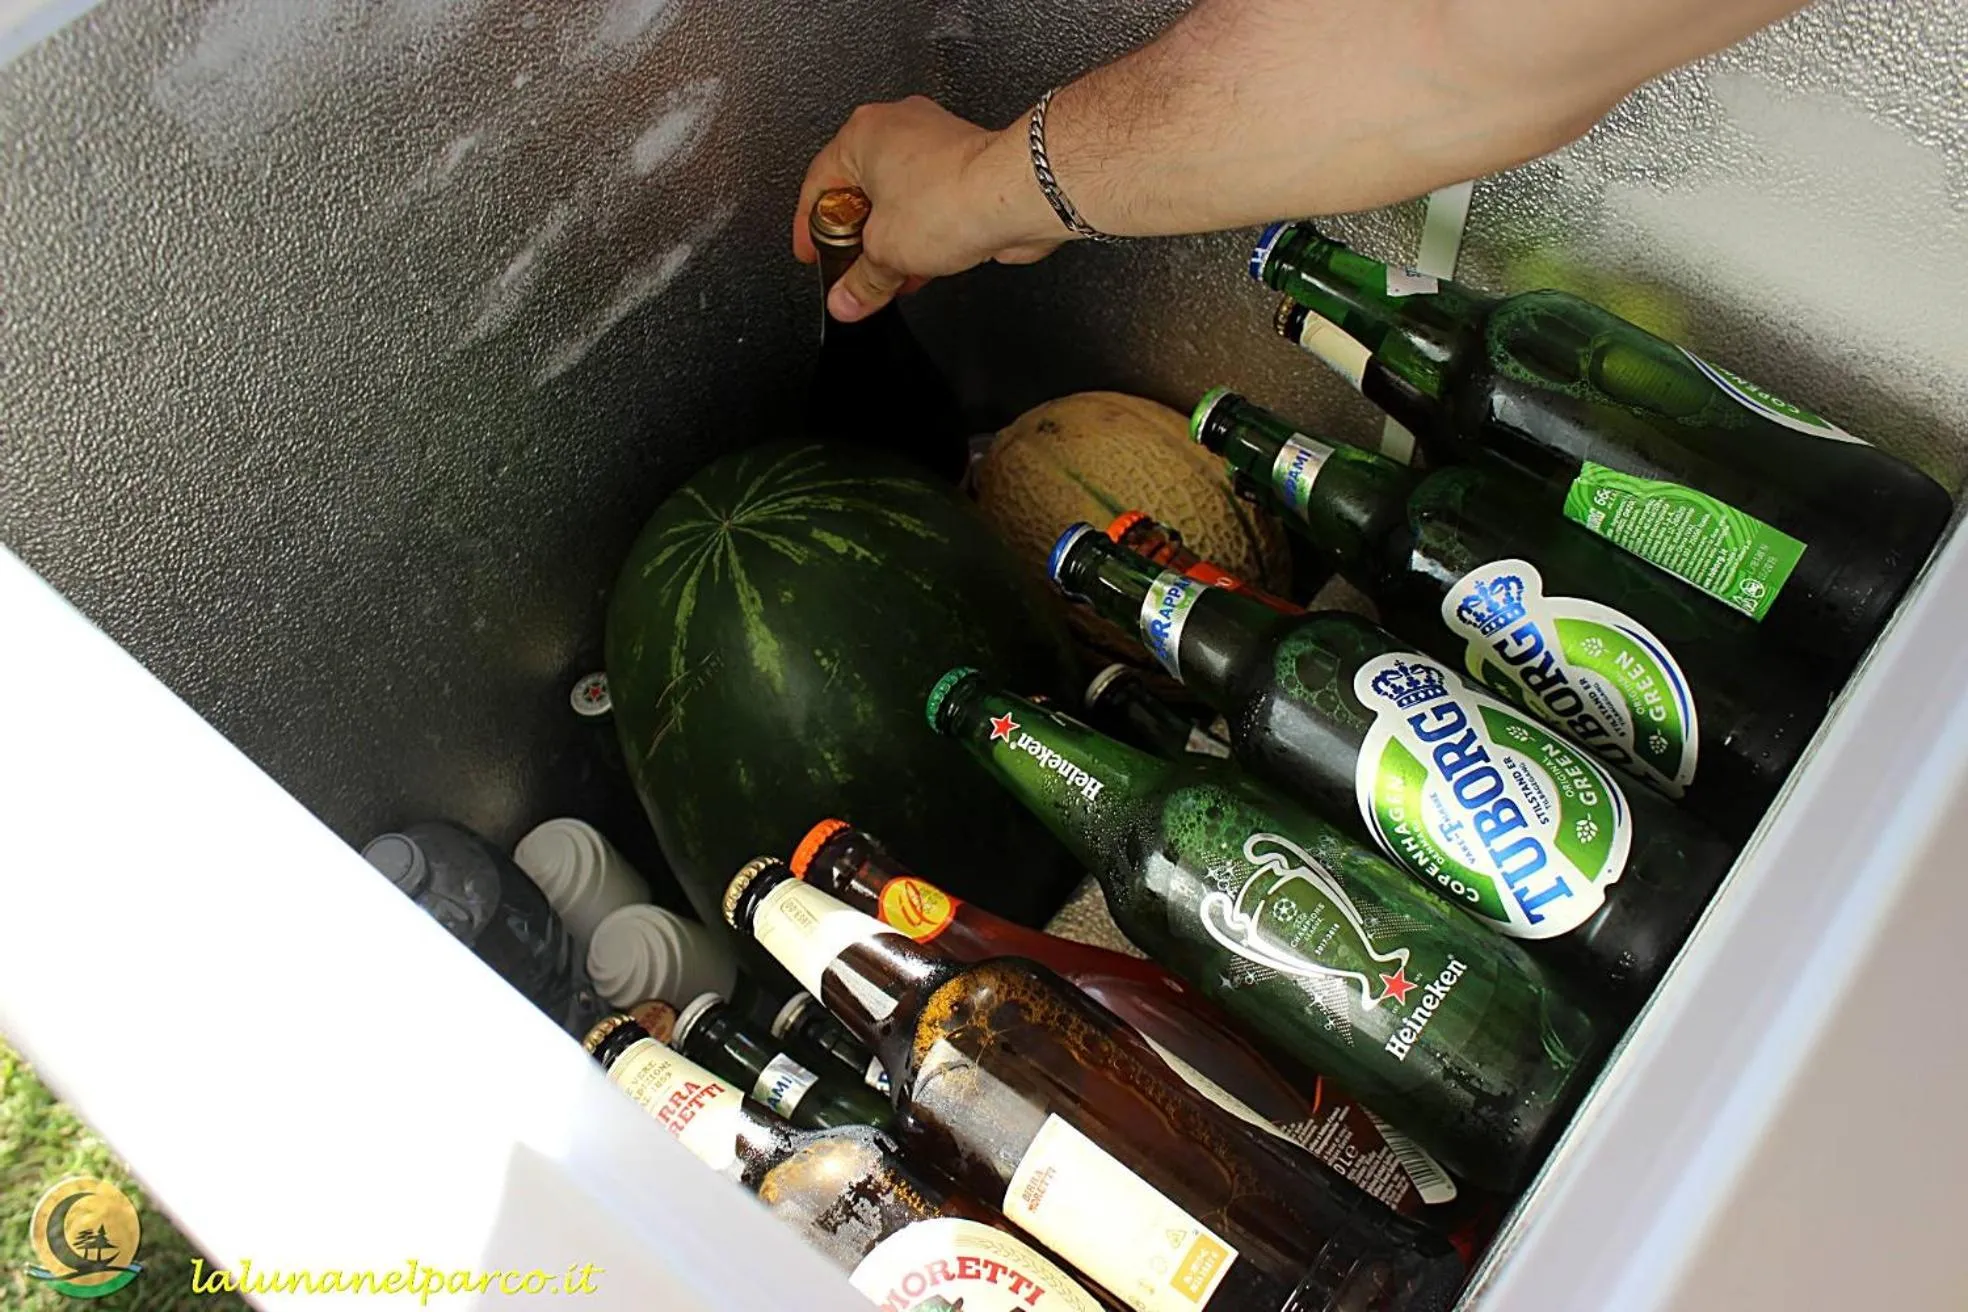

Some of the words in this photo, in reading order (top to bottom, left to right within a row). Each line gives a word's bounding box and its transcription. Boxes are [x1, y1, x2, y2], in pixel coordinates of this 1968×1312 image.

[1492, 621, 1636, 767] UBORG
[1614, 650, 1667, 723] GREEN
[1017, 732, 1105, 801] Heineken
[1502, 755, 1518, 769] ER
[1541, 743, 1598, 807] GREEN
[1542, 756, 1575, 798] ORIGINAL
[1407, 701, 1574, 925] TUBORG
[1511, 769, 1550, 825] STILSTAND
[1385, 774, 1480, 903] COPENHAGEN
[1290, 902, 1326, 949] CHAMPIONS
[1385, 958, 1468, 1061] Heineken
[667, 1082, 726, 1137] RETTI
[880, 1256, 1046, 1312] MORETTI
